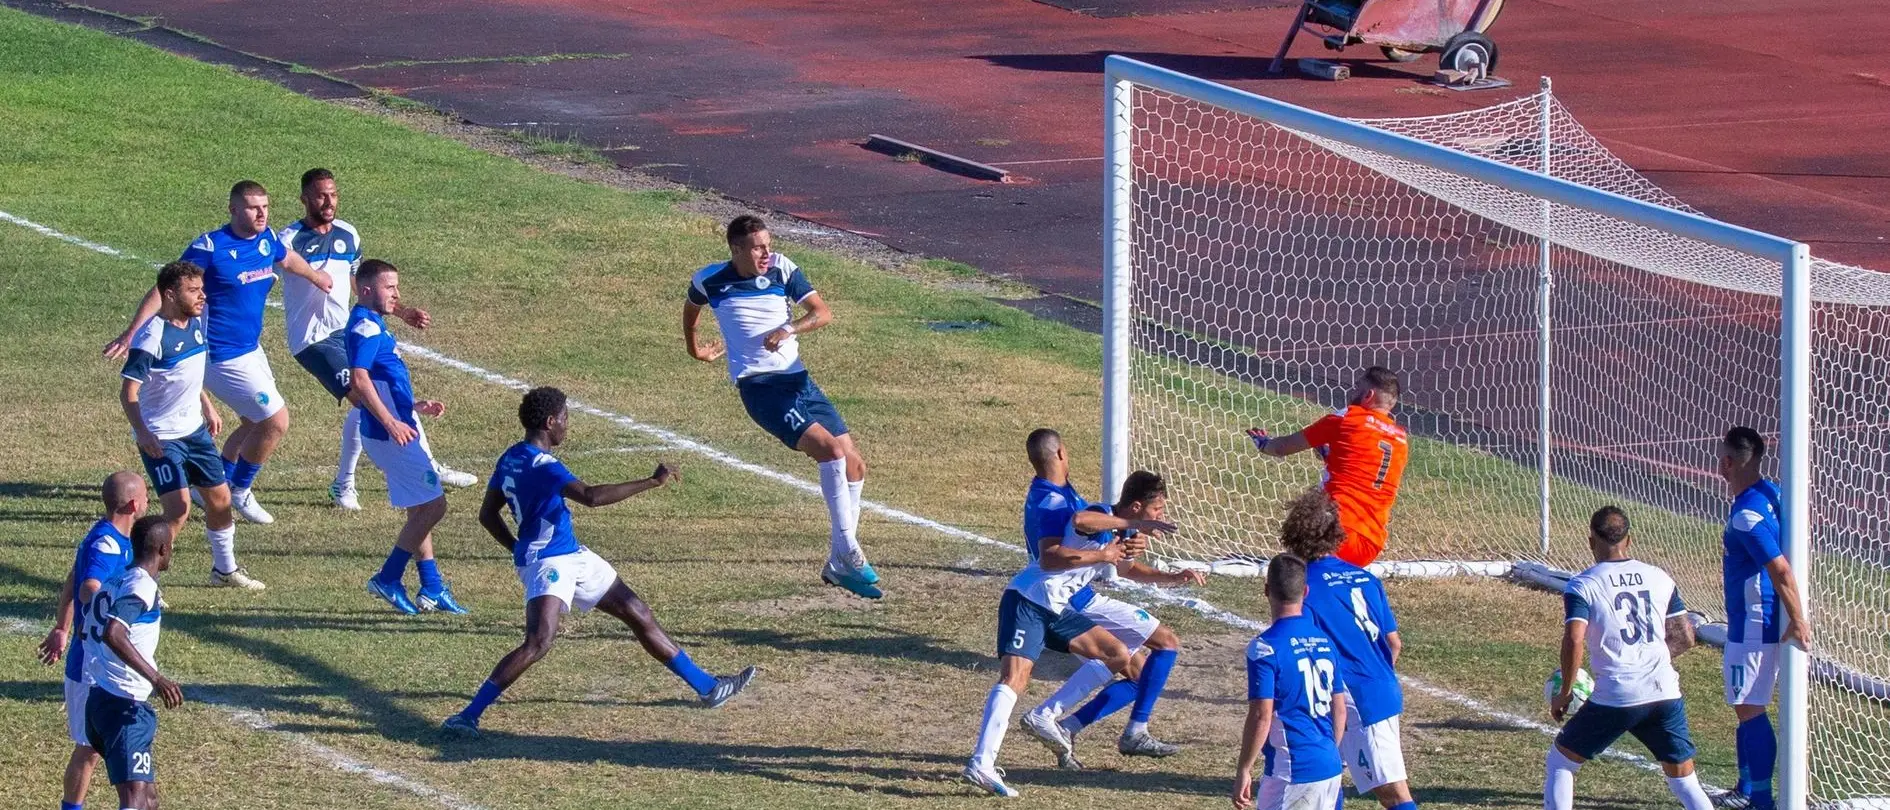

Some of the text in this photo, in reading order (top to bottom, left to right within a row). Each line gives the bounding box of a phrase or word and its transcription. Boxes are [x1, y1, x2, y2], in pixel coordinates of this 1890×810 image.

[336, 368, 350, 387] 23
[784, 407, 806, 431] 21
[155, 464, 173, 485] 10
[1372, 440, 1393, 490] 1
[1609, 573, 1643, 587] LAZO
[1350, 587, 1379, 642] 4
[1614, 590, 1654, 645] 31
[1013, 629, 1026, 649] 5
[1731, 665, 1744, 687] 11
[1297, 657, 1334, 718] 19
[133, 752, 150, 774] 29
[1358, 748, 1370, 769] 4
